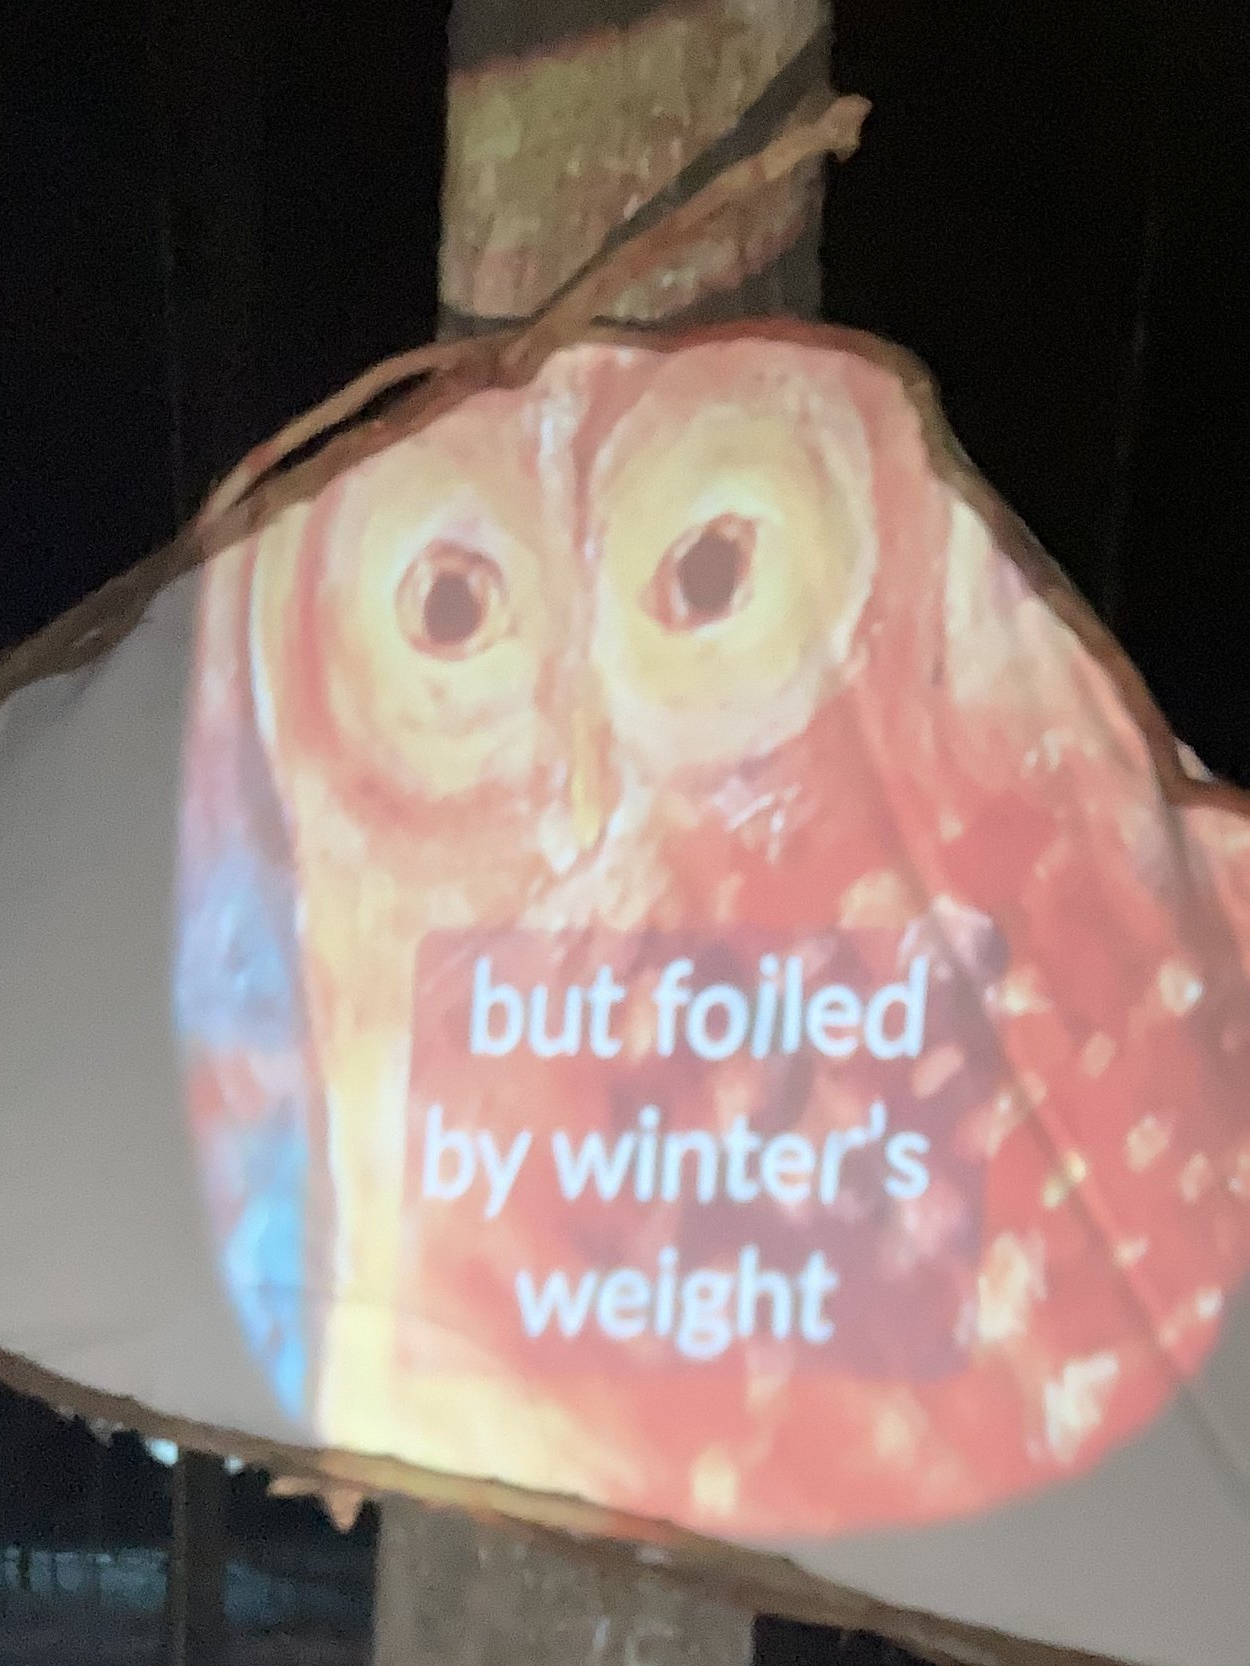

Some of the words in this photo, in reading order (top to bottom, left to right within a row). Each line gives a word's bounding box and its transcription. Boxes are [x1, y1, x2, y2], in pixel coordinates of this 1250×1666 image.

[469, 954, 626, 1060] but
[652, 952, 929, 1060] foiled
[422, 1103, 532, 1220] by
[552, 1101, 930, 1203] winter's
[515, 1244, 838, 1359] weight
